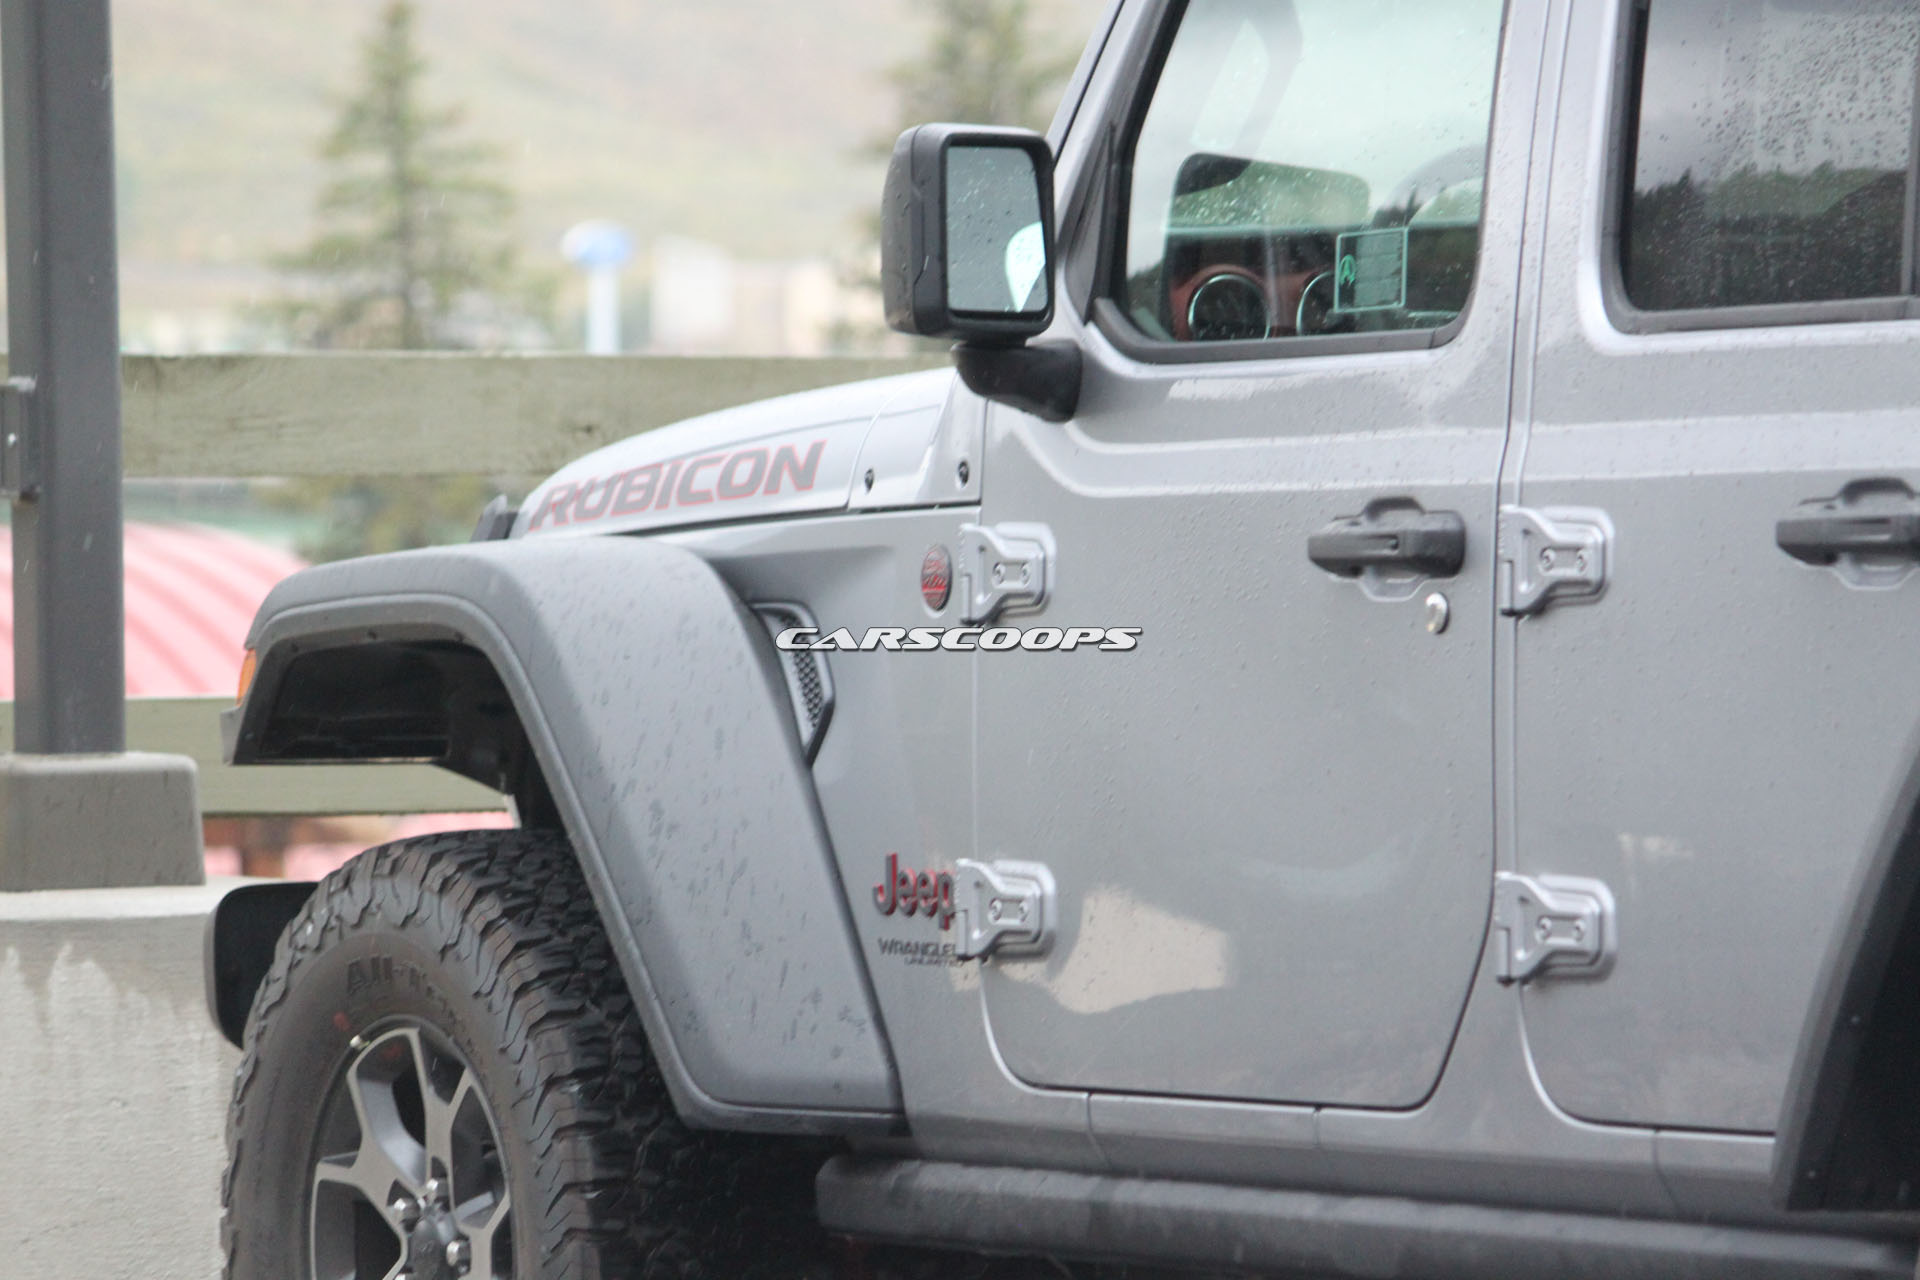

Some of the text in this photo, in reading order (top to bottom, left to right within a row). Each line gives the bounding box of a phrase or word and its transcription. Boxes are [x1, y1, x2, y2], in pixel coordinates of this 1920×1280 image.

[528, 439, 827, 531] RUBICON
[872, 852, 956, 930] Jeep
[877, 937, 957, 956] WRANGLE
